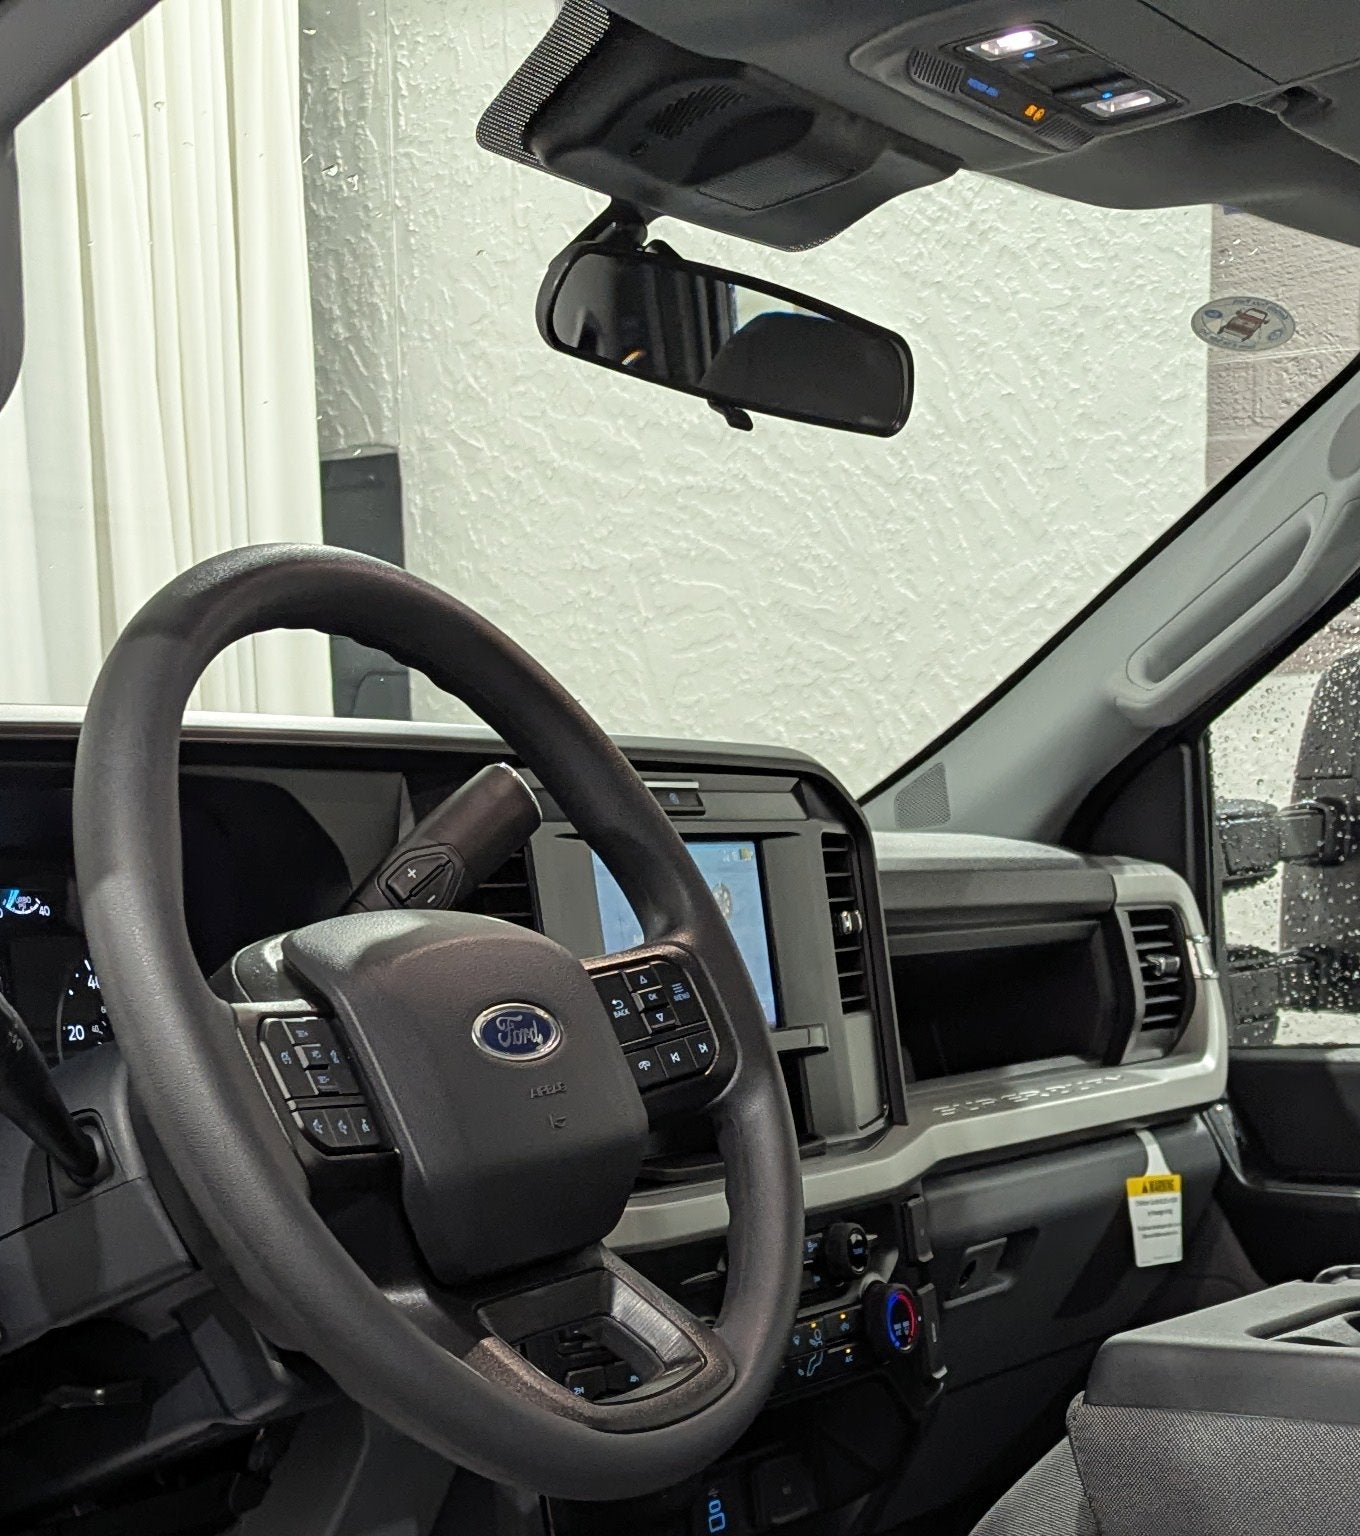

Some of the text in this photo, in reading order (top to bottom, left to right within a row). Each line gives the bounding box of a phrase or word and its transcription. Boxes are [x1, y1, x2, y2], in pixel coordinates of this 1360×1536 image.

[39, 905, 50, 917] 40
[613, 1008, 631, 1019] BACK
[67, 1024, 85, 1041] 20
[496, 1014, 543, 1048] Ford
